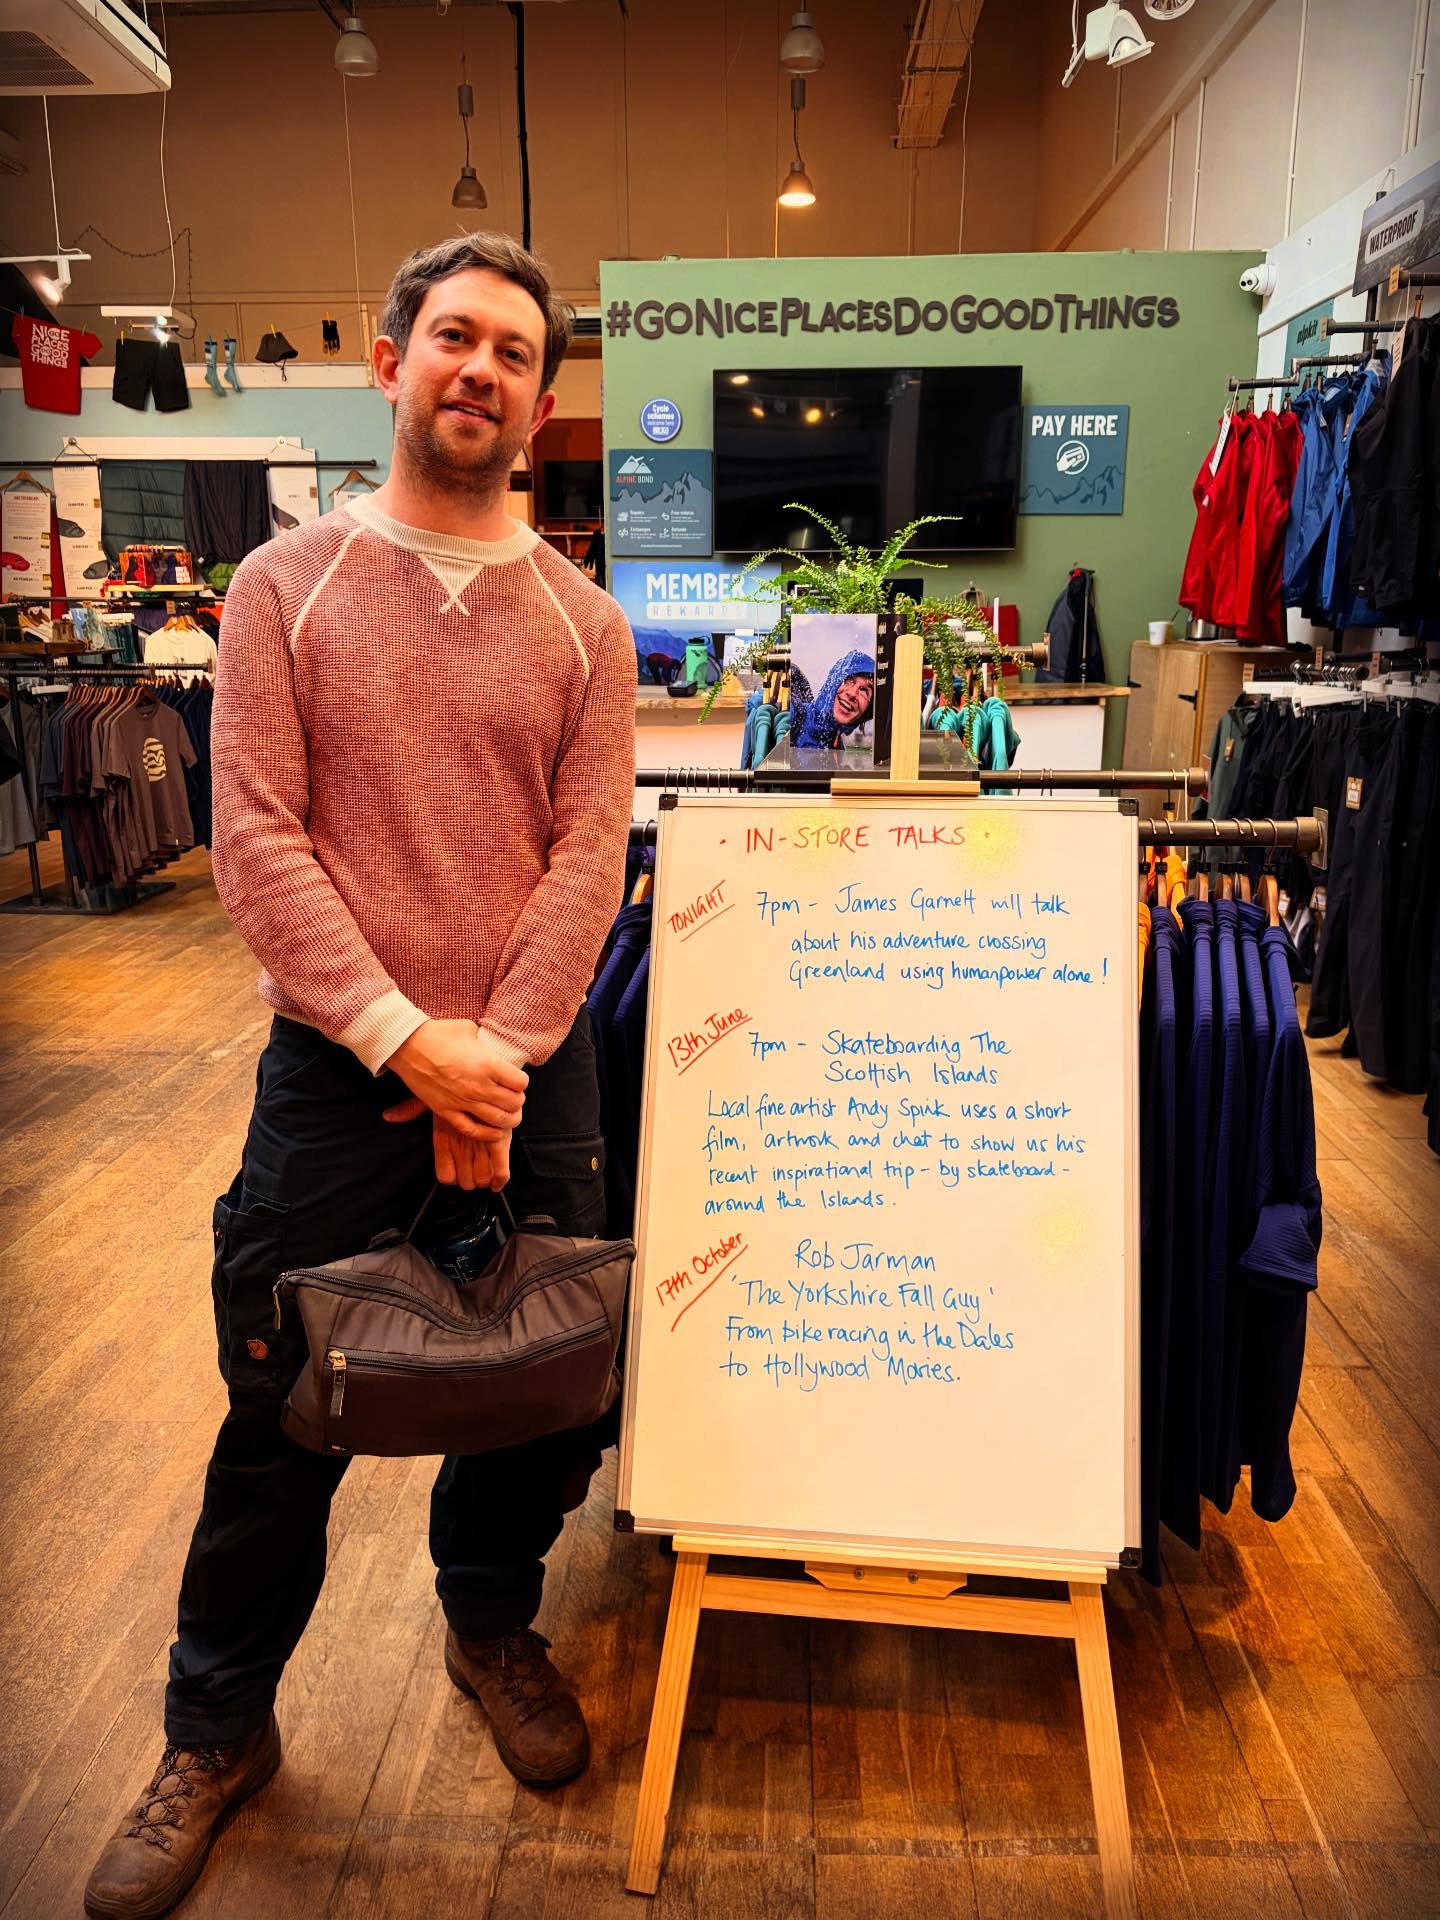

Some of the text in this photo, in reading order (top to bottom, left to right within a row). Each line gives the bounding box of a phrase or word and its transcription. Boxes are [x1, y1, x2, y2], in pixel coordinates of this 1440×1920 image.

[1370, 210, 1418, 255] WATERPROOF
[32, 323, 70, 343] NICE
[32, 335, 69, 351] PLACES
[31, 344, 68, 359] GOOD
[653, 404, 669, 413] Cycle
[1031, 415, 1118, 436] PAY HERE
[616, 475, 654, 484] ALPINE BOND
[646, 573, 745, 600] MEMBER
[888, 826, 965, 847] TALKS
[666, 879, 726, 933] TONIGHT
[757, 892, 800, 926] 7pm
[835, 883, 896, 913] James
[911, 888, 976, 921] Garnett
[991, 894, 1022, 919] will
[1031, 892, 1070, 915] talk
[792, 930, 1046, 959] about his adventure crossing
[790, 960, 884, 989] Greenland
[901, 966, 944, 990] using
[668, 1008, 748, 1068] 13th June
[749, 1032, 786, 1061] 7pm
[822, 1030, 960, 1063] Skateboarding
[970, 1032, 1011, 1054] The
[825, 1060, 997, 1088] Scottish Islands
[708, 1090, 749, 1118] Local
[790, 1097, 836, 1117] artist
[848, 1096, 888, 1129] Andy
[898, 1098, 950, 1127] Spink
[961, 1104, 996, 1119] uses
[1006, 1106, 1017, 1120] a
[1025, 1100, 1071, 1119] short
[765, 1130, 839, 1150] artwork
[848, 1133, 880, 1147] and
[893, 1130, 932, 1148] chat
[939, 1133, 959, 1150] to
[971, 1135, 1014, 1151] show
[1027, 1139, 1048, 1152] us
[1057, 1134, 1086, 1153] his
[710, 1164, 759, 1186] recent
[773, 1160, 872, 1191] inspirational
[883, 1161, 914, 1189] trip
[940, 1160, 959, 1187] by
[705, 1196, 765, 1215] around
[777, 1190, 805, 1209] the
[656, 1232, 742, 1306] 17th October
[795, 1239, 935, 1272] Rob Jarman
[788, 1280, 888, 1309] Yorkshire
[898, 1283, 935, 1309] Fall
[725, 1316, 773, 1344] From
[898, 1322, 915, 1345] in
[922, 1322, 956, 1349] the
[957, 1322, 1013, 1350] Dales
[719, 1354, 747, 1377] to
[764, 1352, 869, 1392] Hollywood
